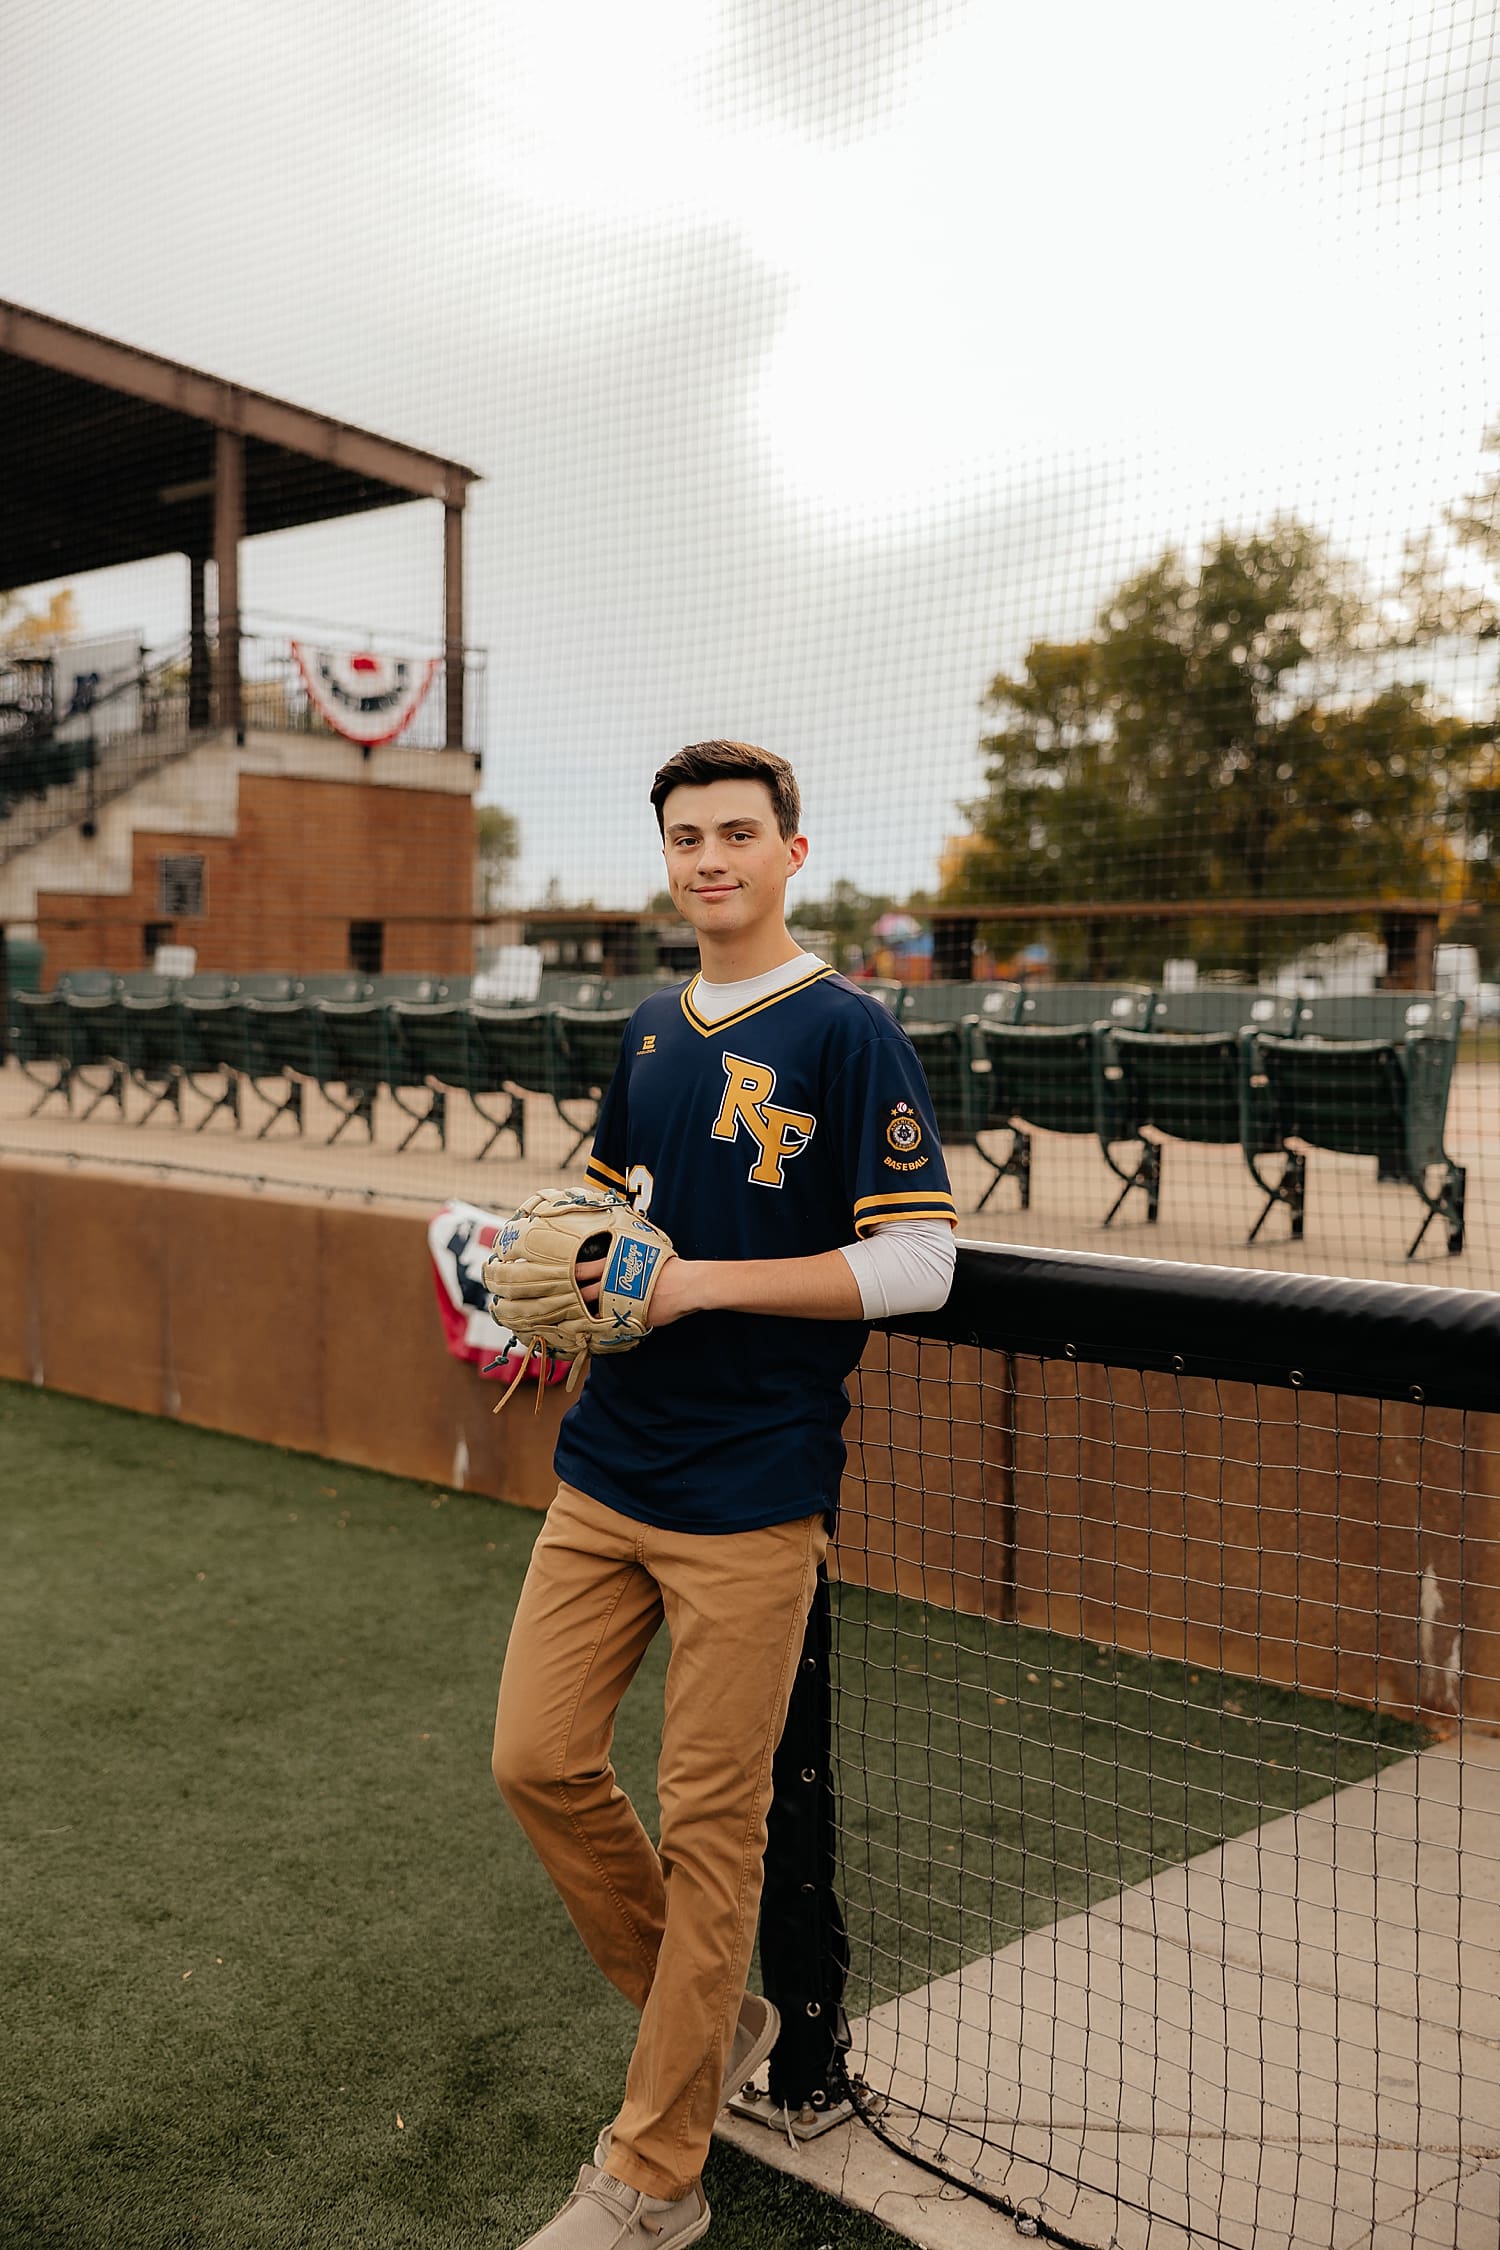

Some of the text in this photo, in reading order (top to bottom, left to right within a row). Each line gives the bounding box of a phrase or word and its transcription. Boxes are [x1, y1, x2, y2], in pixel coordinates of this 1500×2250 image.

[711, 1051, 816, 1189] RF
[883, 1156, 929, 1171] BASEBALL
[618, 1243, 643, 1291] Rawlings
